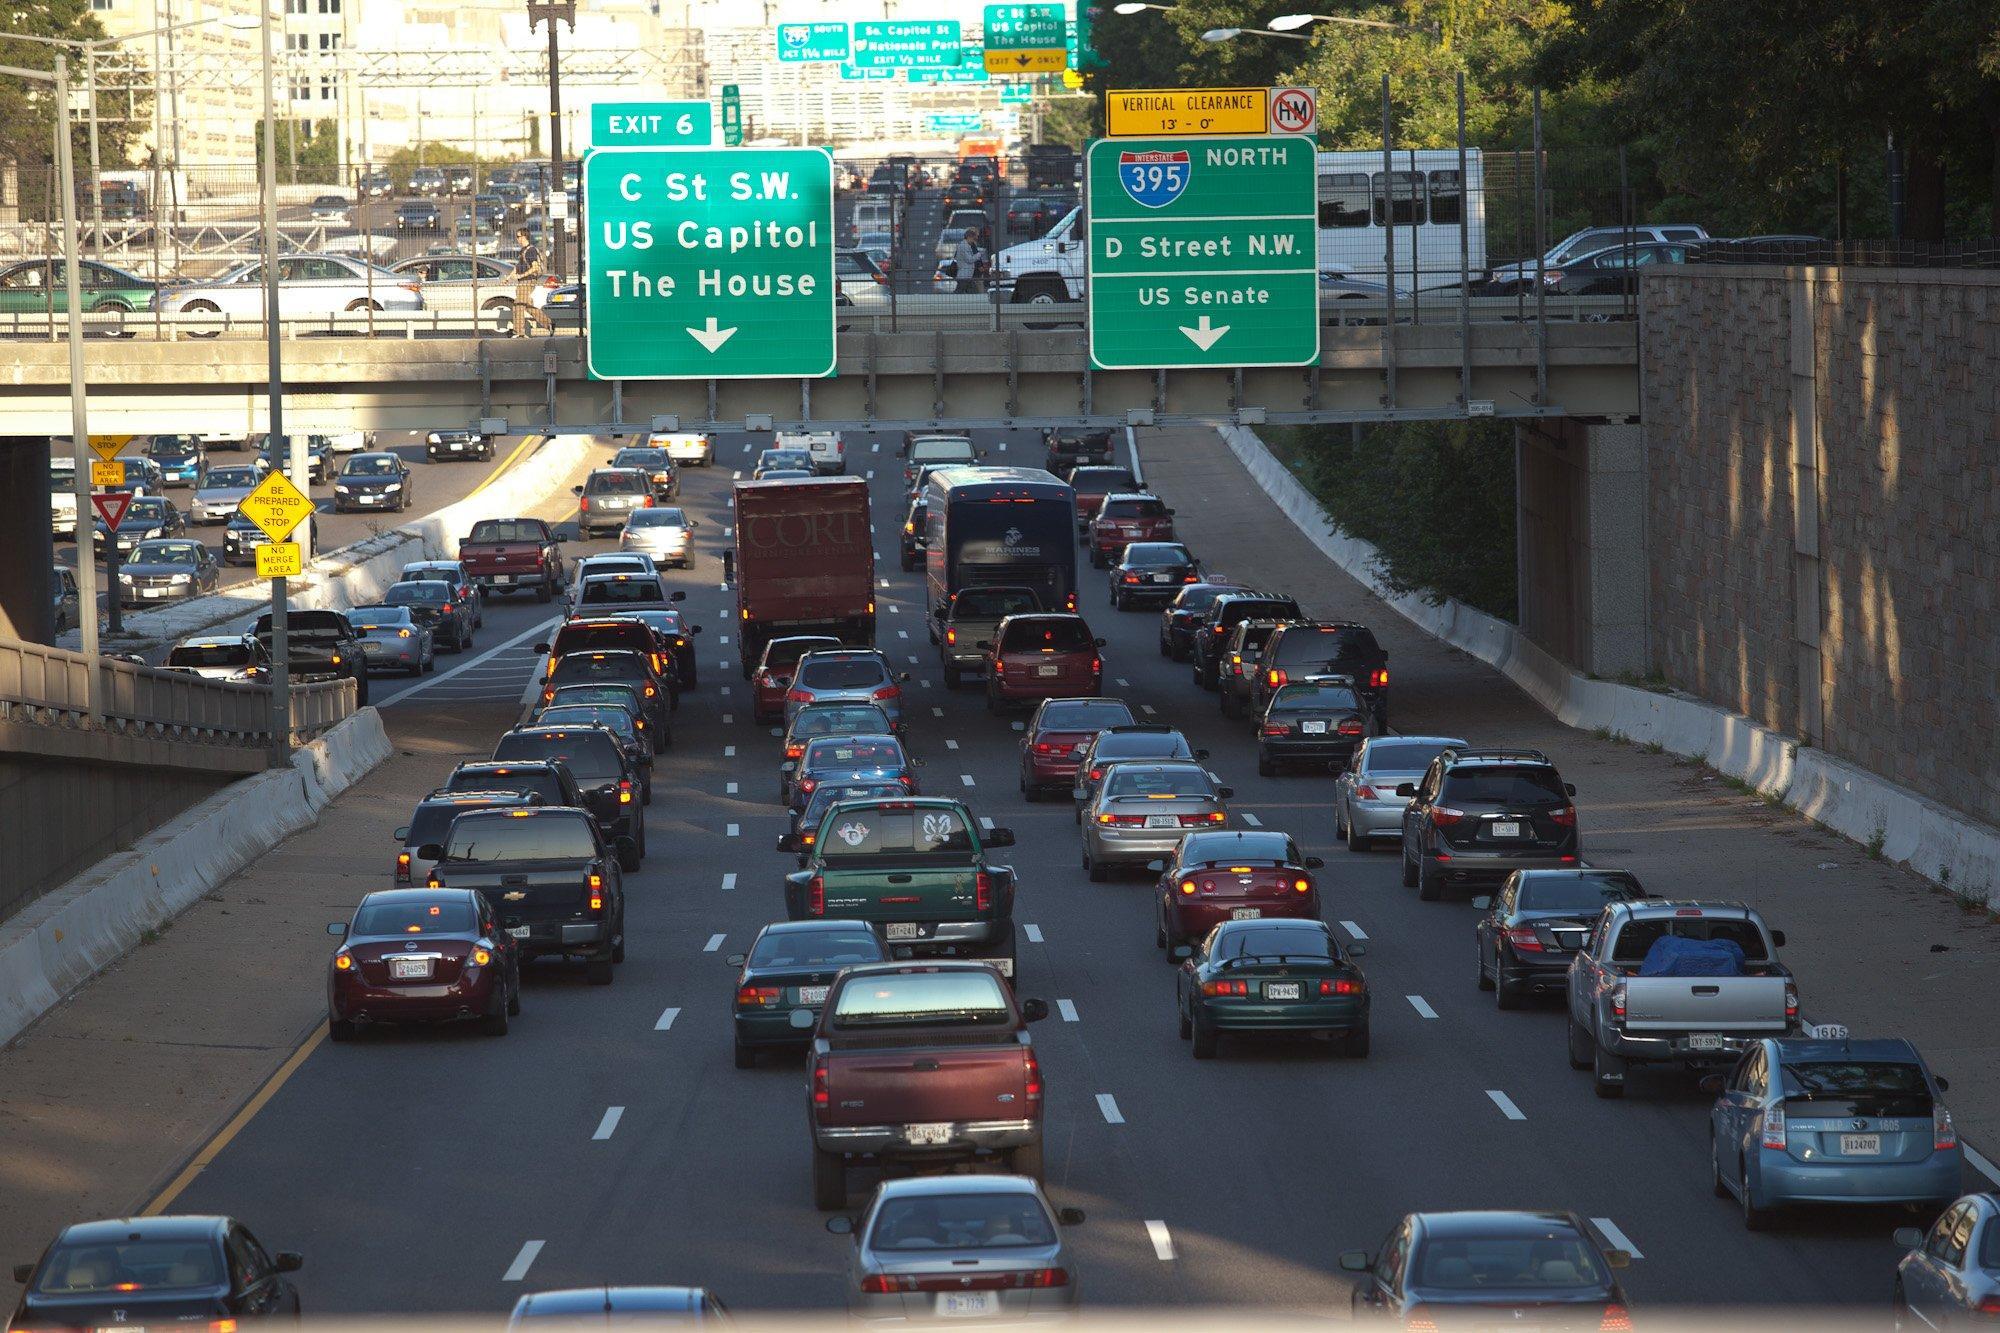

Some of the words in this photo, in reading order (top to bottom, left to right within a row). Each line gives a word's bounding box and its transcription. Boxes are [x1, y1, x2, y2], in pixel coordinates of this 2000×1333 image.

[997, 8, 1005, 19] C
[887, 26, 931, 37] Capitol
[1014, 22, 1057, 32] Capitol
[931, 40, 960, 50] Park
[994, 36, 1015, 45] The
[1021, 35, 1057, 44] House
[1036, 56, 1062, 64] ONLY
[1122, 97, 1176, 111] VERTICAL
[1187, 95, 1253, 110] CLEARANCE
[1279, 101, 1308, 121] HM
[609, 115, 662, 134] EXIT
[676, 113, 694, 135] 6
[1134, 152, 1175, 162] INTERSTATE
[1206, 148, 1287, 166] NORTH
[1131, 165, 1182, 192] 395
[620, 173, 642, 201] C
[666, 173, 707, 201] St
[730, 171, 799, 200] S.W.
[604, 221, 654, 250] US
[677, 220, 817, 254] Capitol
[1105, 237, 1123, 258] D
[1140, 235, 1232, 258] Street
[1248, 234, 1302, 256] N.W.
[606, 270, 675, 297] The
[699, 269, 816, 296] House
[1138, 287, 1171, 306] US
[1184, 286, 1270, 305] Senate
[97, 441, 117, 449] STOP
[271, 486, 284, 495] BE
[254, 497, 300, 506] PREPARED
[270, 508, 284, 516] TO
[264, 518, 290, 527] STOP
[263, 556, 294, 564] MERGE
[267, 566, 292, 574] AREA
[1816, 1026, 1846, 1039] 1605
[1880, 1119, 1901, 1132] 1605
